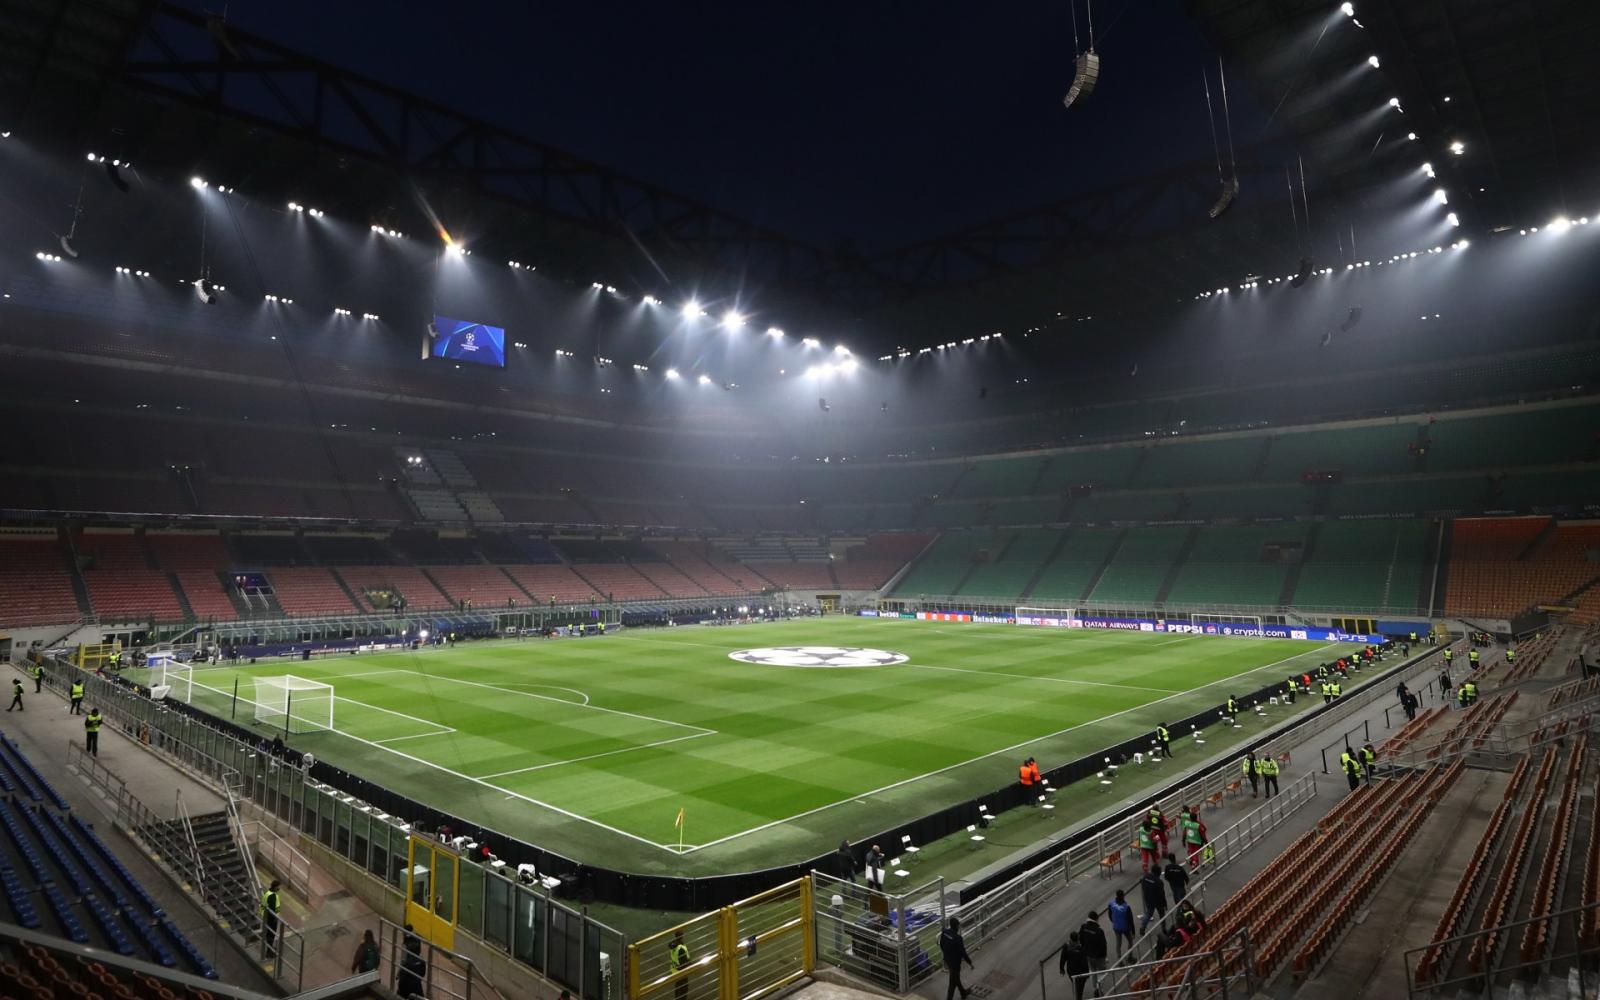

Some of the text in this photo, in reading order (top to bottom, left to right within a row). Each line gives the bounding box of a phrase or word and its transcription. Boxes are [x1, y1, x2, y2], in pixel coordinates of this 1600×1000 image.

[973, 615, 1007, 624] Heineken
[1084, 620, 1139, 630] QATAR AIRWAYS
[1168, 624, 1203, 634] PEPSI
[1234, 628, 1286, 637] crypto.com
[1340, 633, 1367, 642] PS5
